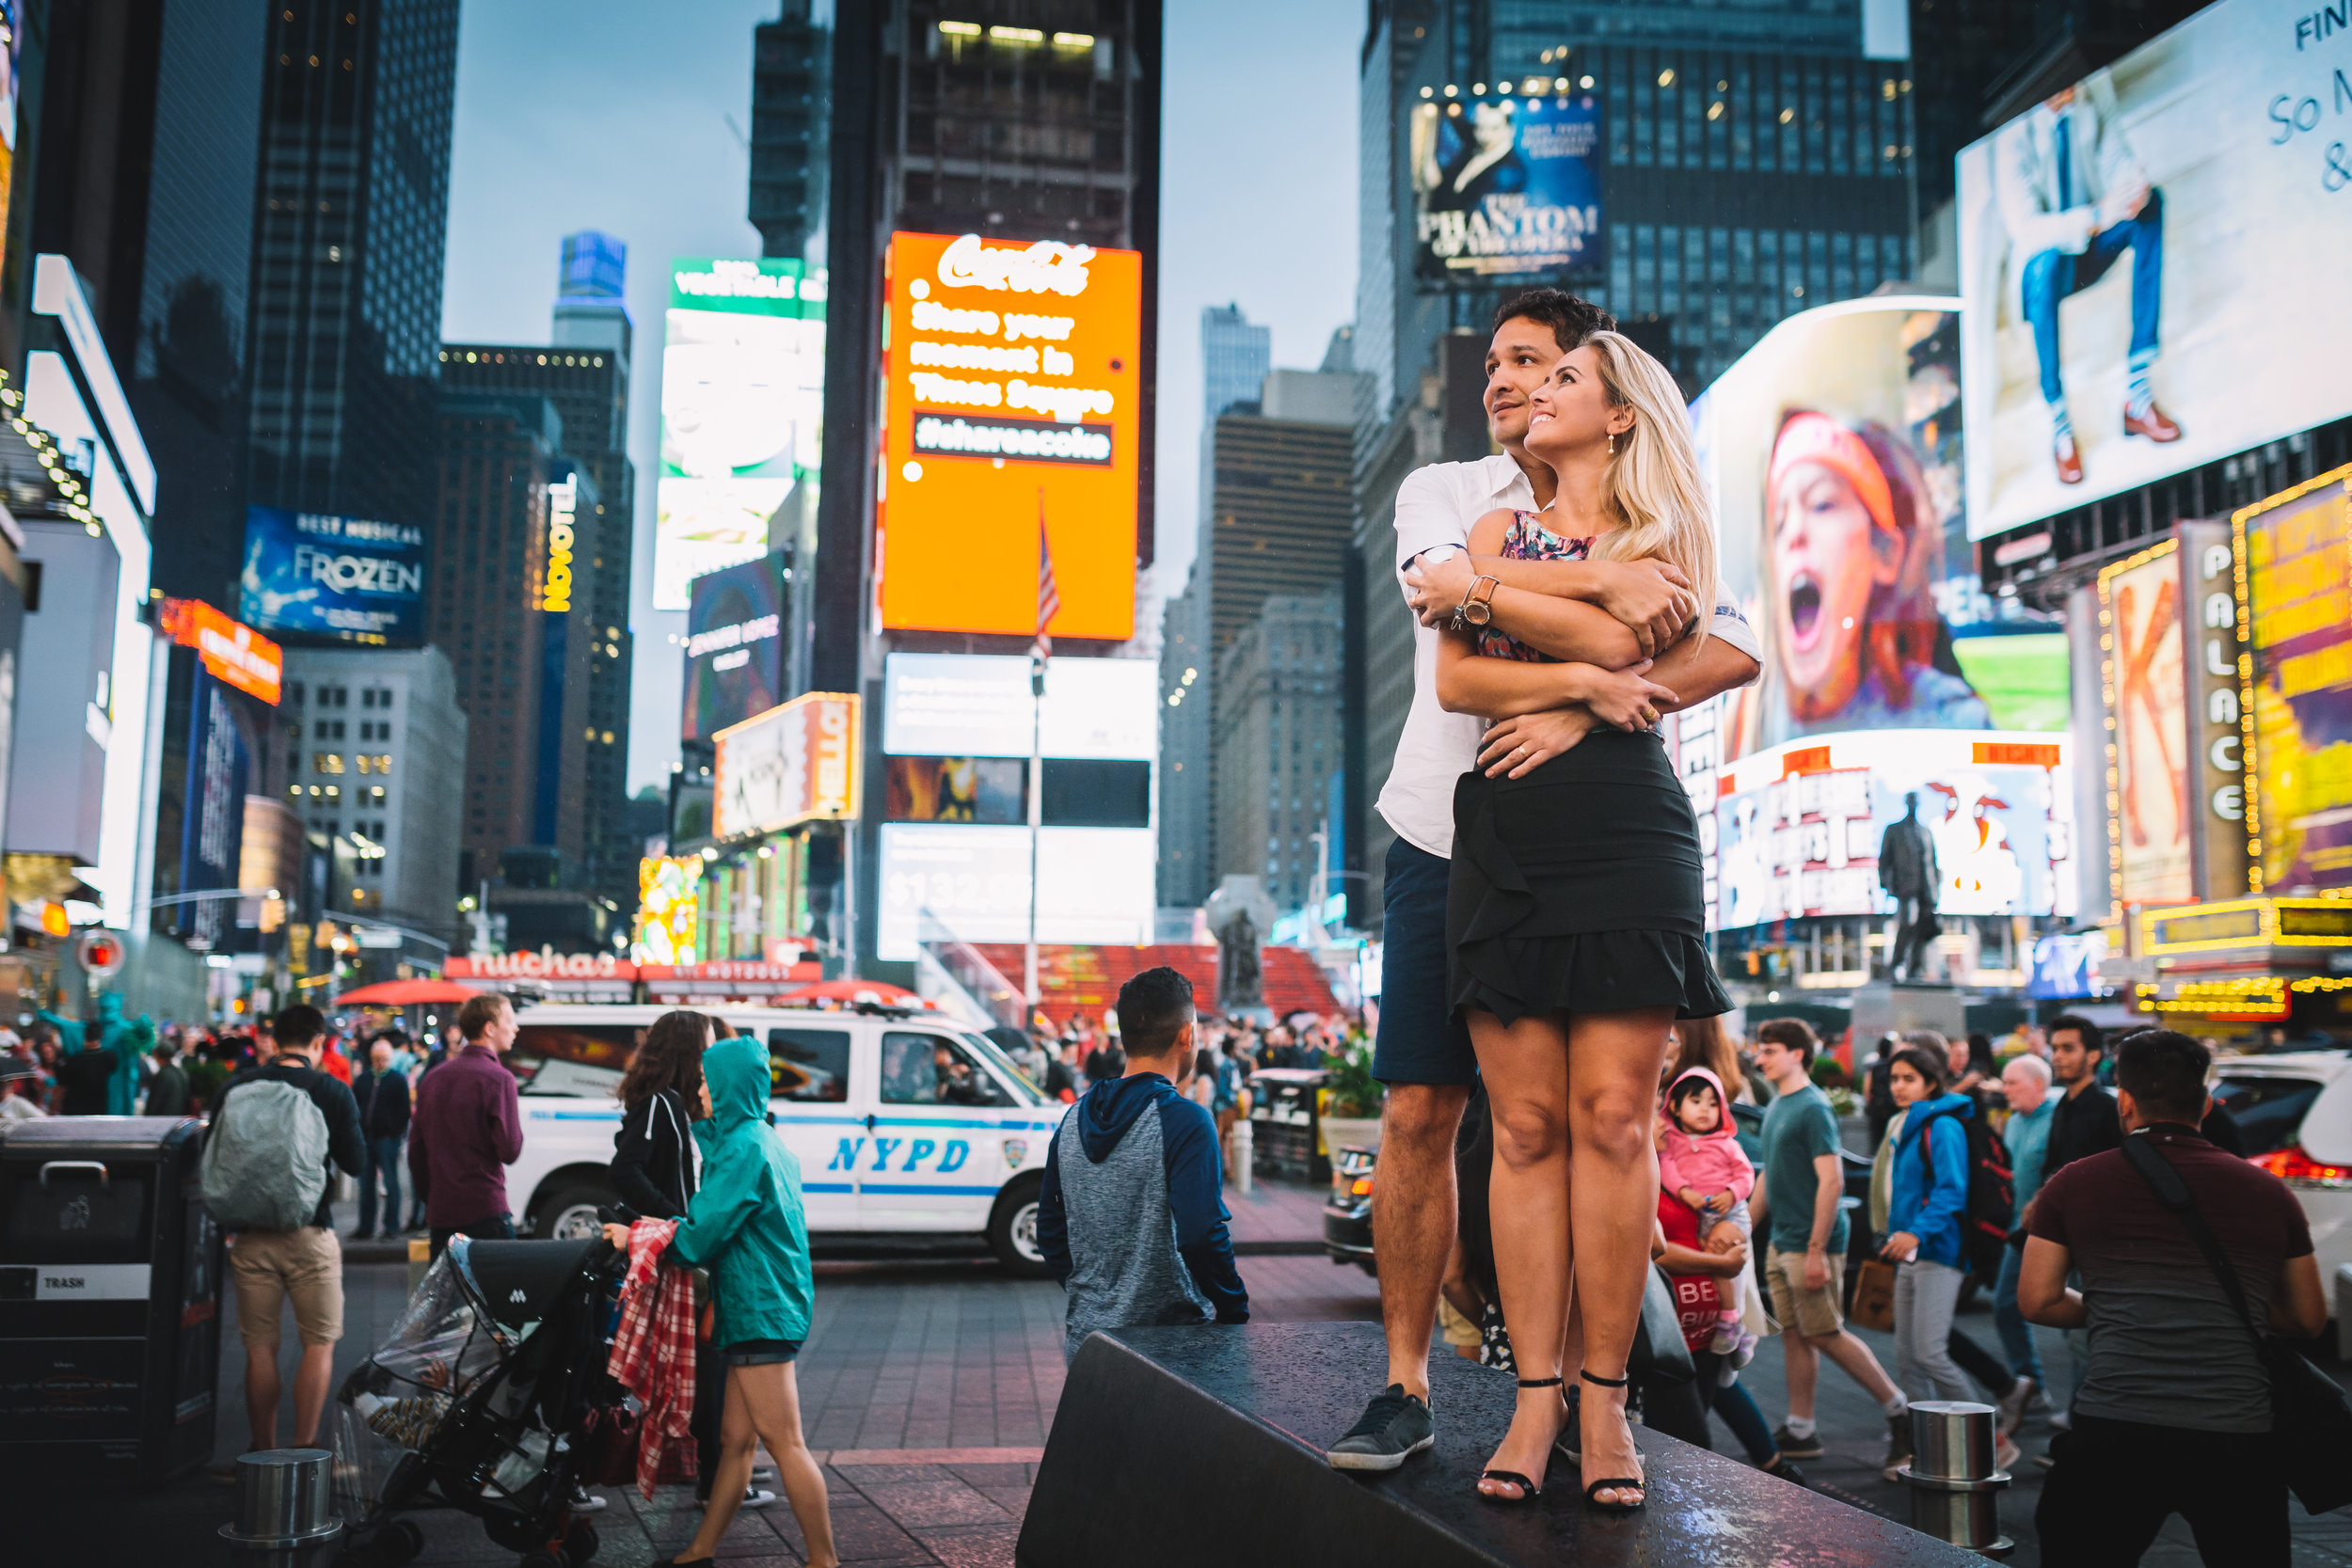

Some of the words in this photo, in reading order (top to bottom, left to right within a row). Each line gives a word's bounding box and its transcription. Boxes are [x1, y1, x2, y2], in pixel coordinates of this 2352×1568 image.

[2296, 0, 2352, 52] FIN
[1418, 204, 1597, 243] PHANTOM
[912, 300, 1000, 336] Share
[1003, 312, 1075, 341] your
[909, 341, 1040, 374] moment
[909, 372, 1003, 406] Times
[1006, 378, 1114, 415] Square
[915, 417, 1111, 461] #shareacoke
[542, 471, 578, 612] NOVOTEL
[294, 543, 421, 596] FROZEN
[2202, 543, 2244, 821] PALACE
[469, 942, 619, 978] nuchas
[827, 1136, 970, 1173] NYPD
[44, 1276, 86, 1290] TRASH
